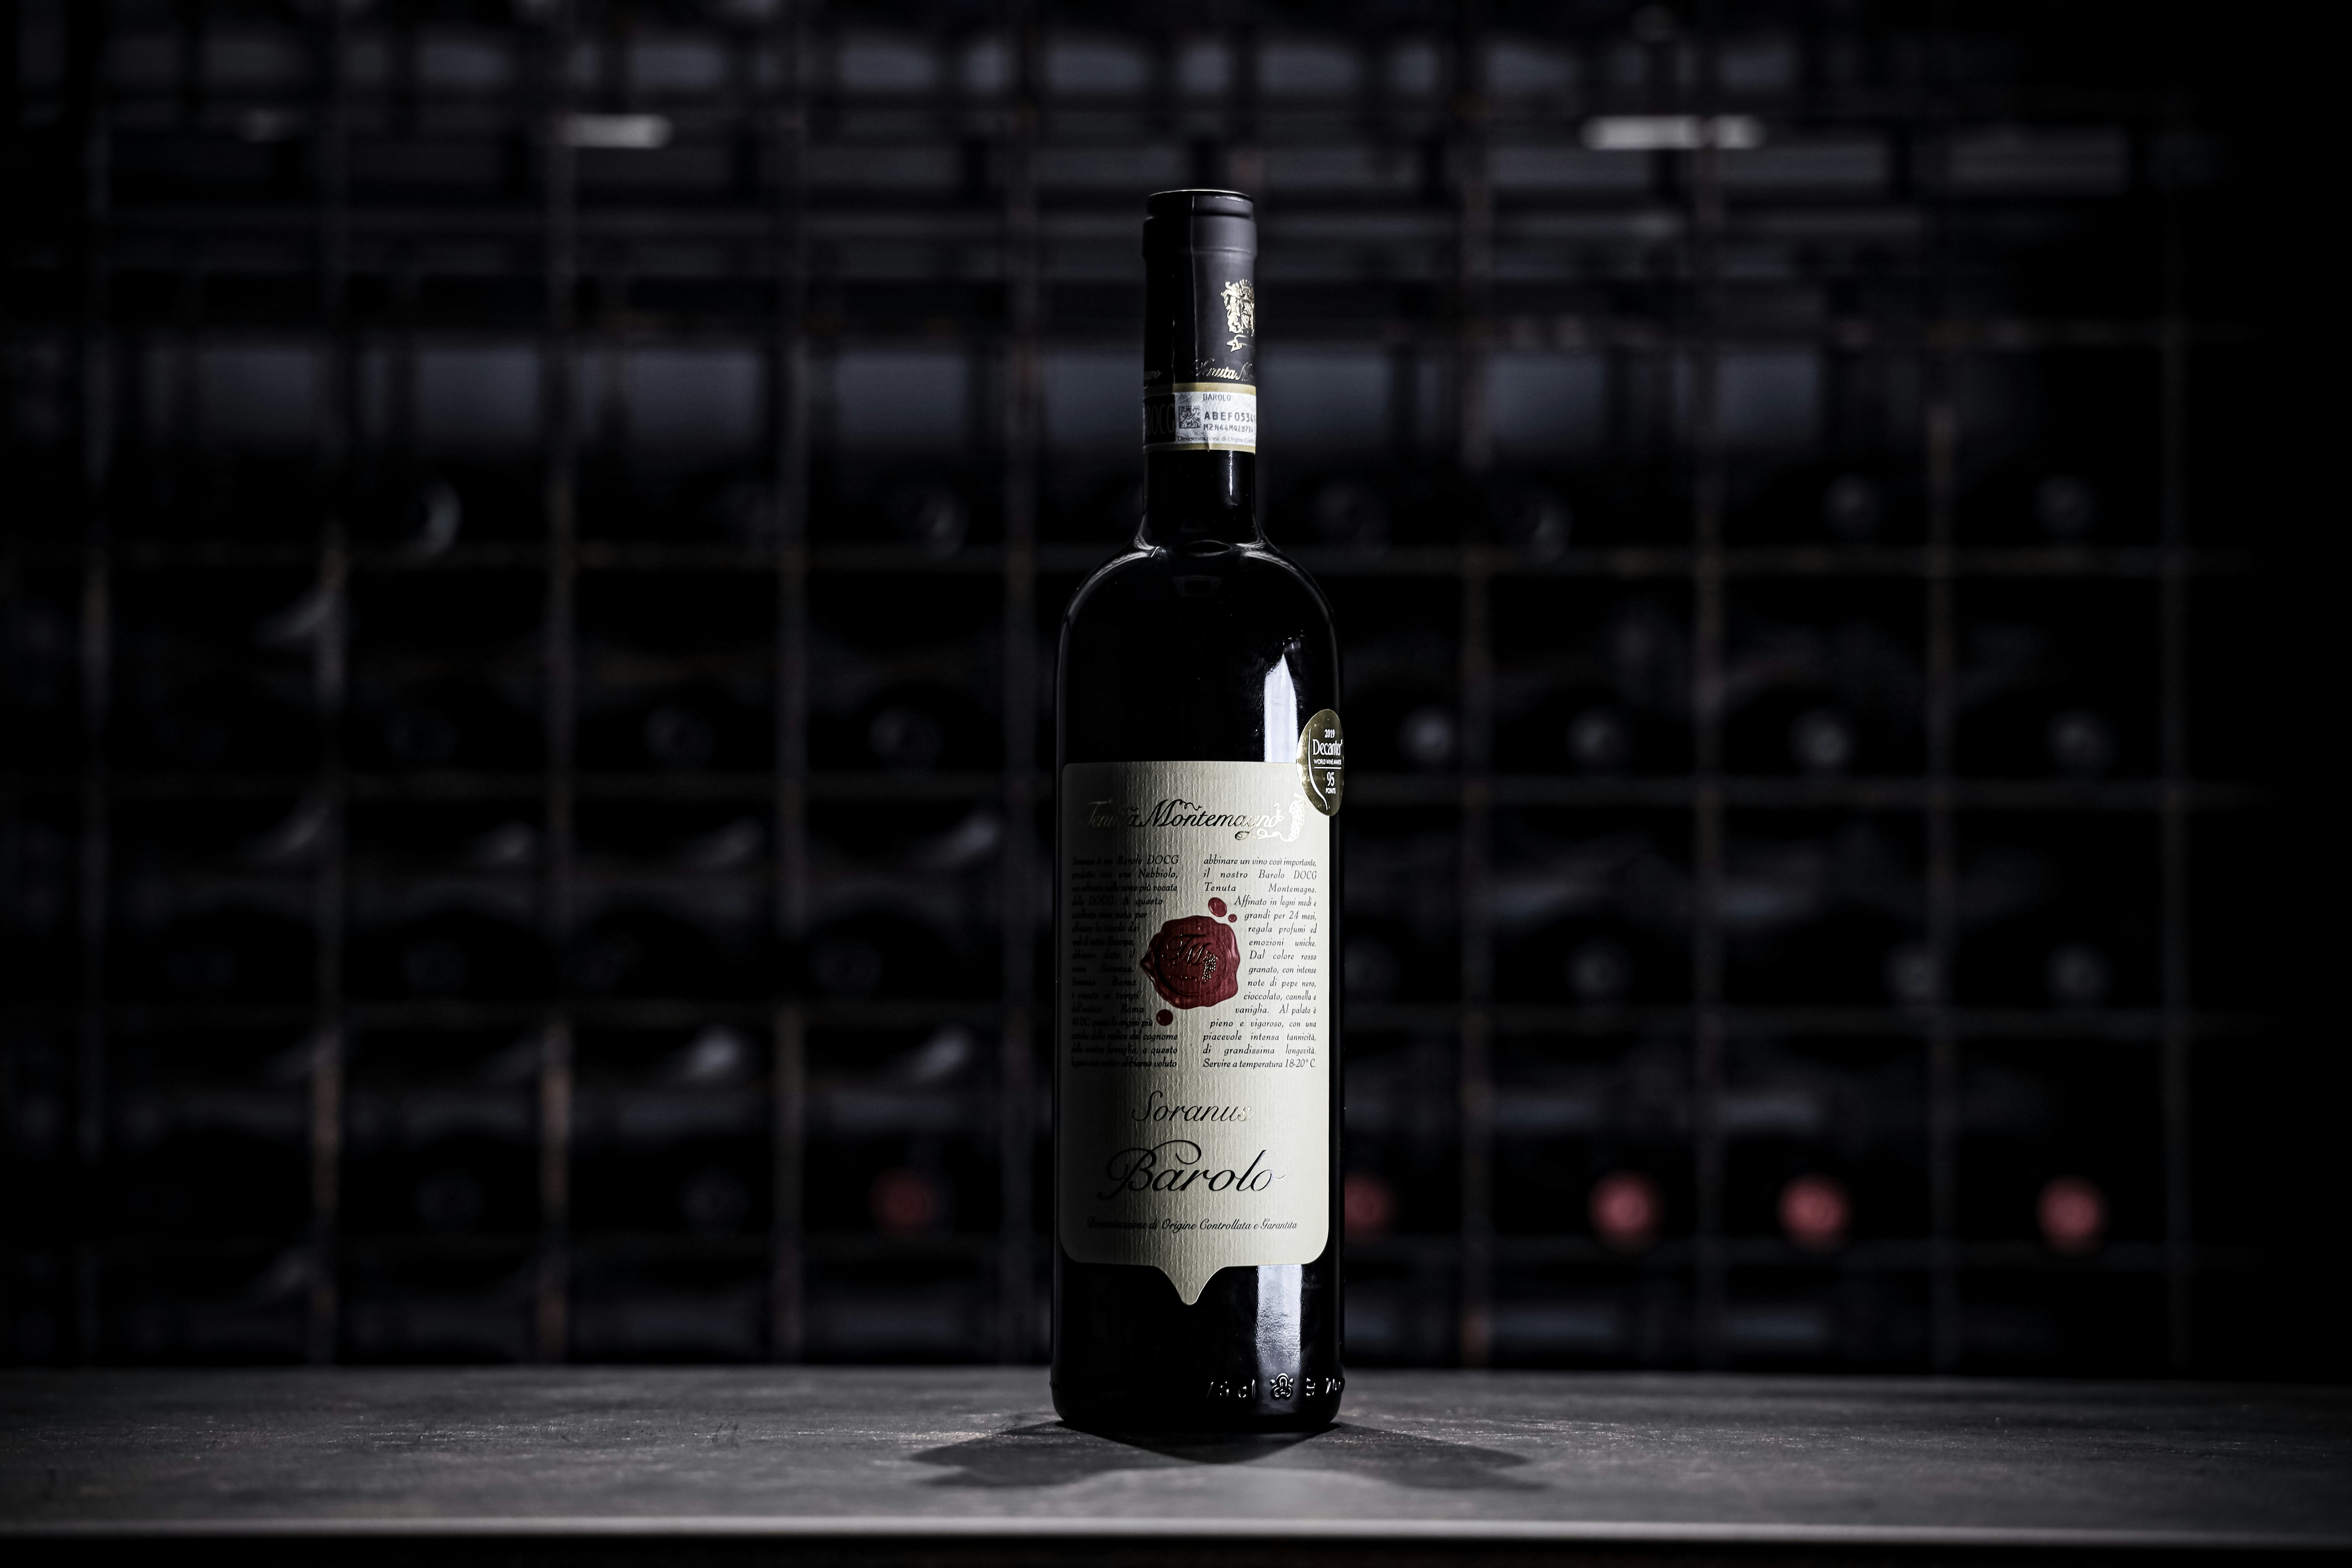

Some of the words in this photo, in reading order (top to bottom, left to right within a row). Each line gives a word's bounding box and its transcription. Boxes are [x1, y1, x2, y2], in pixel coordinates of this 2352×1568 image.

[1325, 729, 1335, 738] 2019
[1312, 739, 1343, 756] Decanter
[1327, 772, 1334, 786] 95
[1083, 798, 1144, 827] Tenua
[1140, 799, 1285, 840] Montemagno
[1072, 856, 1094, 865] Soranus
[1117, 854, 1142, 865] Barolo
[1147, 855, 1179, 864] DOCG
[1204, 854, 1238, 865] abbinare
[1284, 857, 1316, 867] importante,
[1072, 869, 1095, 879] prodotto
[1138, 868, 1178, 879] Nebbiolo,
[1203, 868, 1210, 878] il
[1258, 869, 1285, 879] Barolo
[1294, 870, 1317, 879] DOCG
[1139, 883, 1150, 893] più
[1205, 882, 1236, 891] Tenuta
[1268, 883, 1316, 895] Montemagno.
[1088, 896, 1115, 905] DOCG.
[1123, 895, 1129, 905] A
[1234, 895, 1266, 907] Affinato
[1280, 896, 1295, 907] legni
[1298, 896, 1311, 906] medi
[1245, 908, 1270, 921] grandi
[1289, 911, 1299, 919] 24
[1302, 912, 1316, 920] mesi,
[1096, 922, 1100, 932] le
[1104, 922, 1124, 932] tavole
[1128, 922, 1140, 931] dei
[1248, 922, 1272, 934] regala
[1279, 923, 1305, 935] profumi
[1310, 923, 1317, 933] ed
[1107, 936, 1134, 947] Europa,
[1295, 937, 1316, 946] uniche.
[1104, 949, 1120, 959] dato
[1129, 948, 1134, 960] il
[1249, 949, 1265, 959] Dal
[1273, 949, 1294, 959] colore
[1100, 963, 1133, 972] Soranus.
[1249, 966, 1279, 974] granato,
[1072, 976, 1095, 986] Soranus
[1112, 976, 1135, 986] Barea
[1270, 976, 1277, 986] di
[1104, 991, 1111, 999] ai
[1116, 991, 1139, 1001] tempi
[1243, 990, 1282, 1001] cioccolato,
[1286, 990, 1311, 1000] cannella
[1121, 1004, 1144, 1013] Roma
[1236, 1003, 1269, 1015] vaniglia.
[1279, 1003, 1288, 1013] Al
[1292, 1003, 1310, 1016] palato
[1141, 1019, 1153, 1028] più
[1210, 1019, 1233, 1028] pieno
[1251, 1019, 1284, 1029] vigoroso,
[1130, 1030, 1141, 1040] del
[1203, 1030, 1242, 1042] piacevole
[1251, 1032, 1279, 1040] intensa
[1287, 1033, 1316, 1041] tannicità,
[1085, 1045, 1104, 1053] nostra
[1106, 1043, 1138, 1055] famiglia,
[1151, 1047, 1178, 1055] questo
[1203, 1044, 1211, 1054] di
[1224, 1044, 1275, 1055] grandissima
[1286, 1044, 1316, 1056] longevità.
[1121, 1056, 1152, 1067] abbiamo
[1154, 1056, 1177, 1067] voluto
[1203, 1058, 1231, 1067] Servire
[1240, 1060, 1282, 1070] temperatura
[1285, 1059, 1309, 1067] 18-20°
[1310, 1059, 1316, 1068] C.
[1132, 1091, 1255, 1121] Soranus
[1098, 1140, 1286, 1200] Barolo
[1149, 1218, 1159, 1230] di
[1162, 1218, 1197, 1233] Origine
[1200, 1219, 1252, 1230] Controllata
[1260, 1217, 1298, 1230] Garantita
